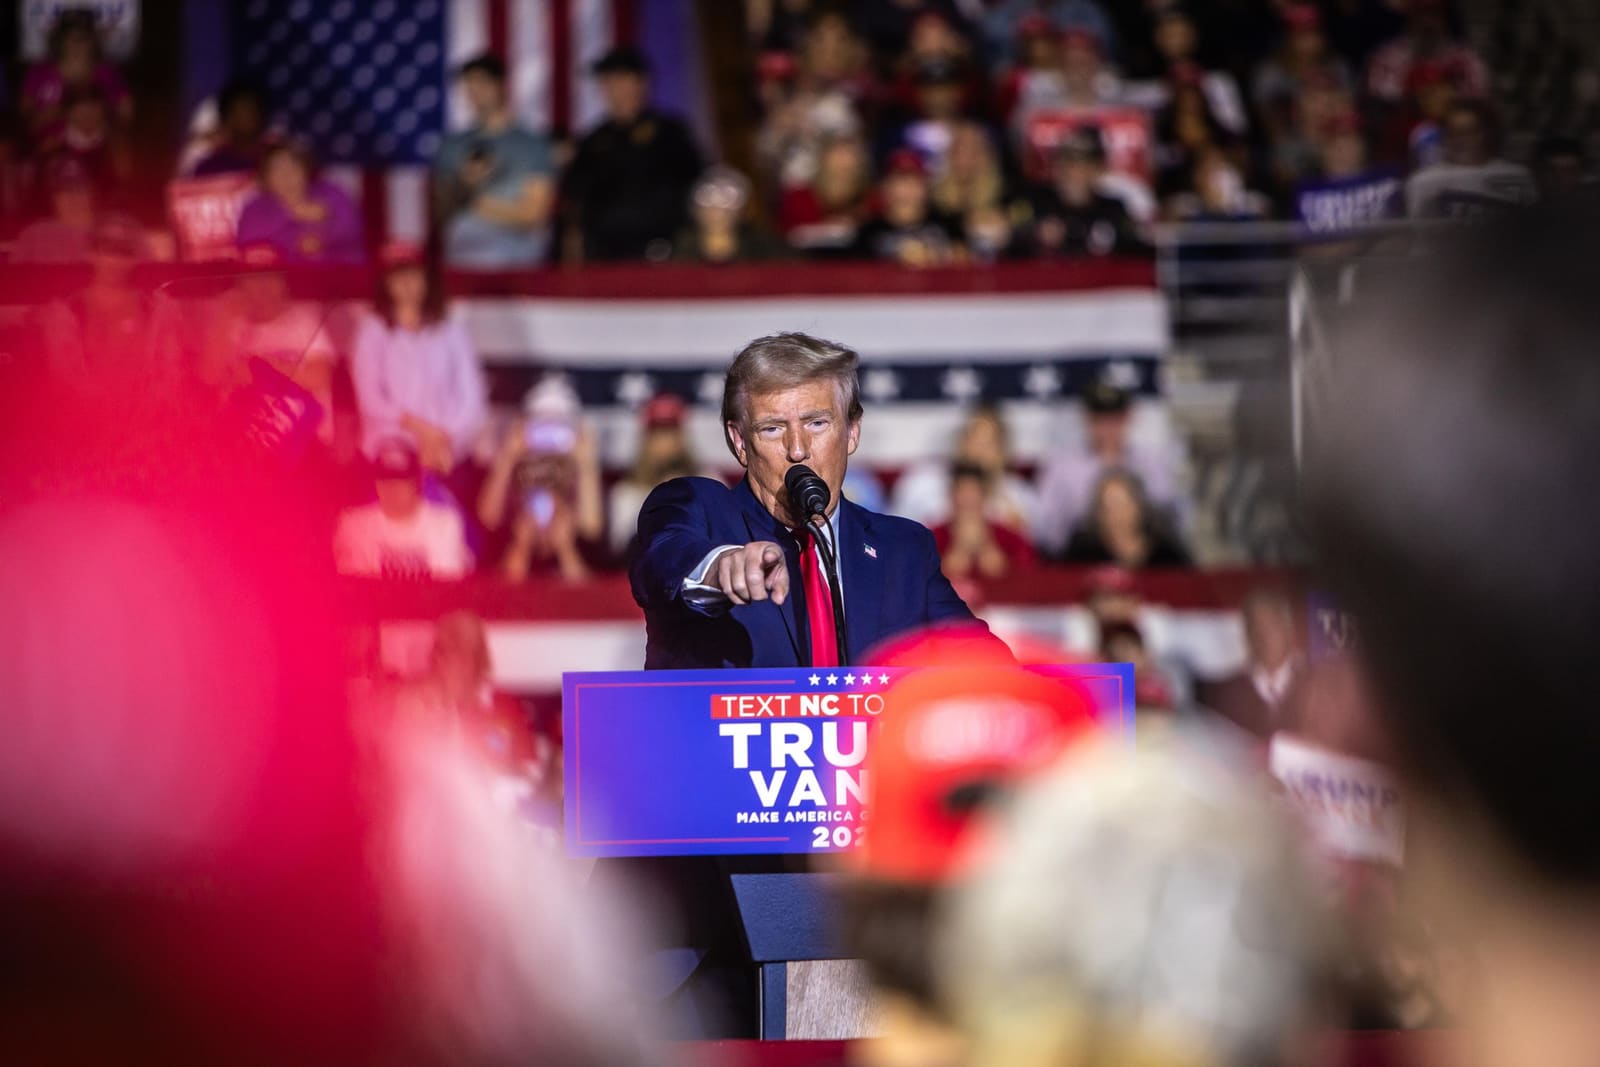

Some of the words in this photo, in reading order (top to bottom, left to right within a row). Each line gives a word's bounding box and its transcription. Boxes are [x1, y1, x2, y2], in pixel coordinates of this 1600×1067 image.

[721, 695, 791, 717] TEXT
[800, 694, 840, 716] NC
[848, 694, 885, 715] TO
[719, 721, 868, 769] TRU
[749, 769, 869, 807] VAN
[736, 812, 779, 823] MAKE
[784, 811, 853, 823] AMERICA
[812, 826, 866, 848] 202
